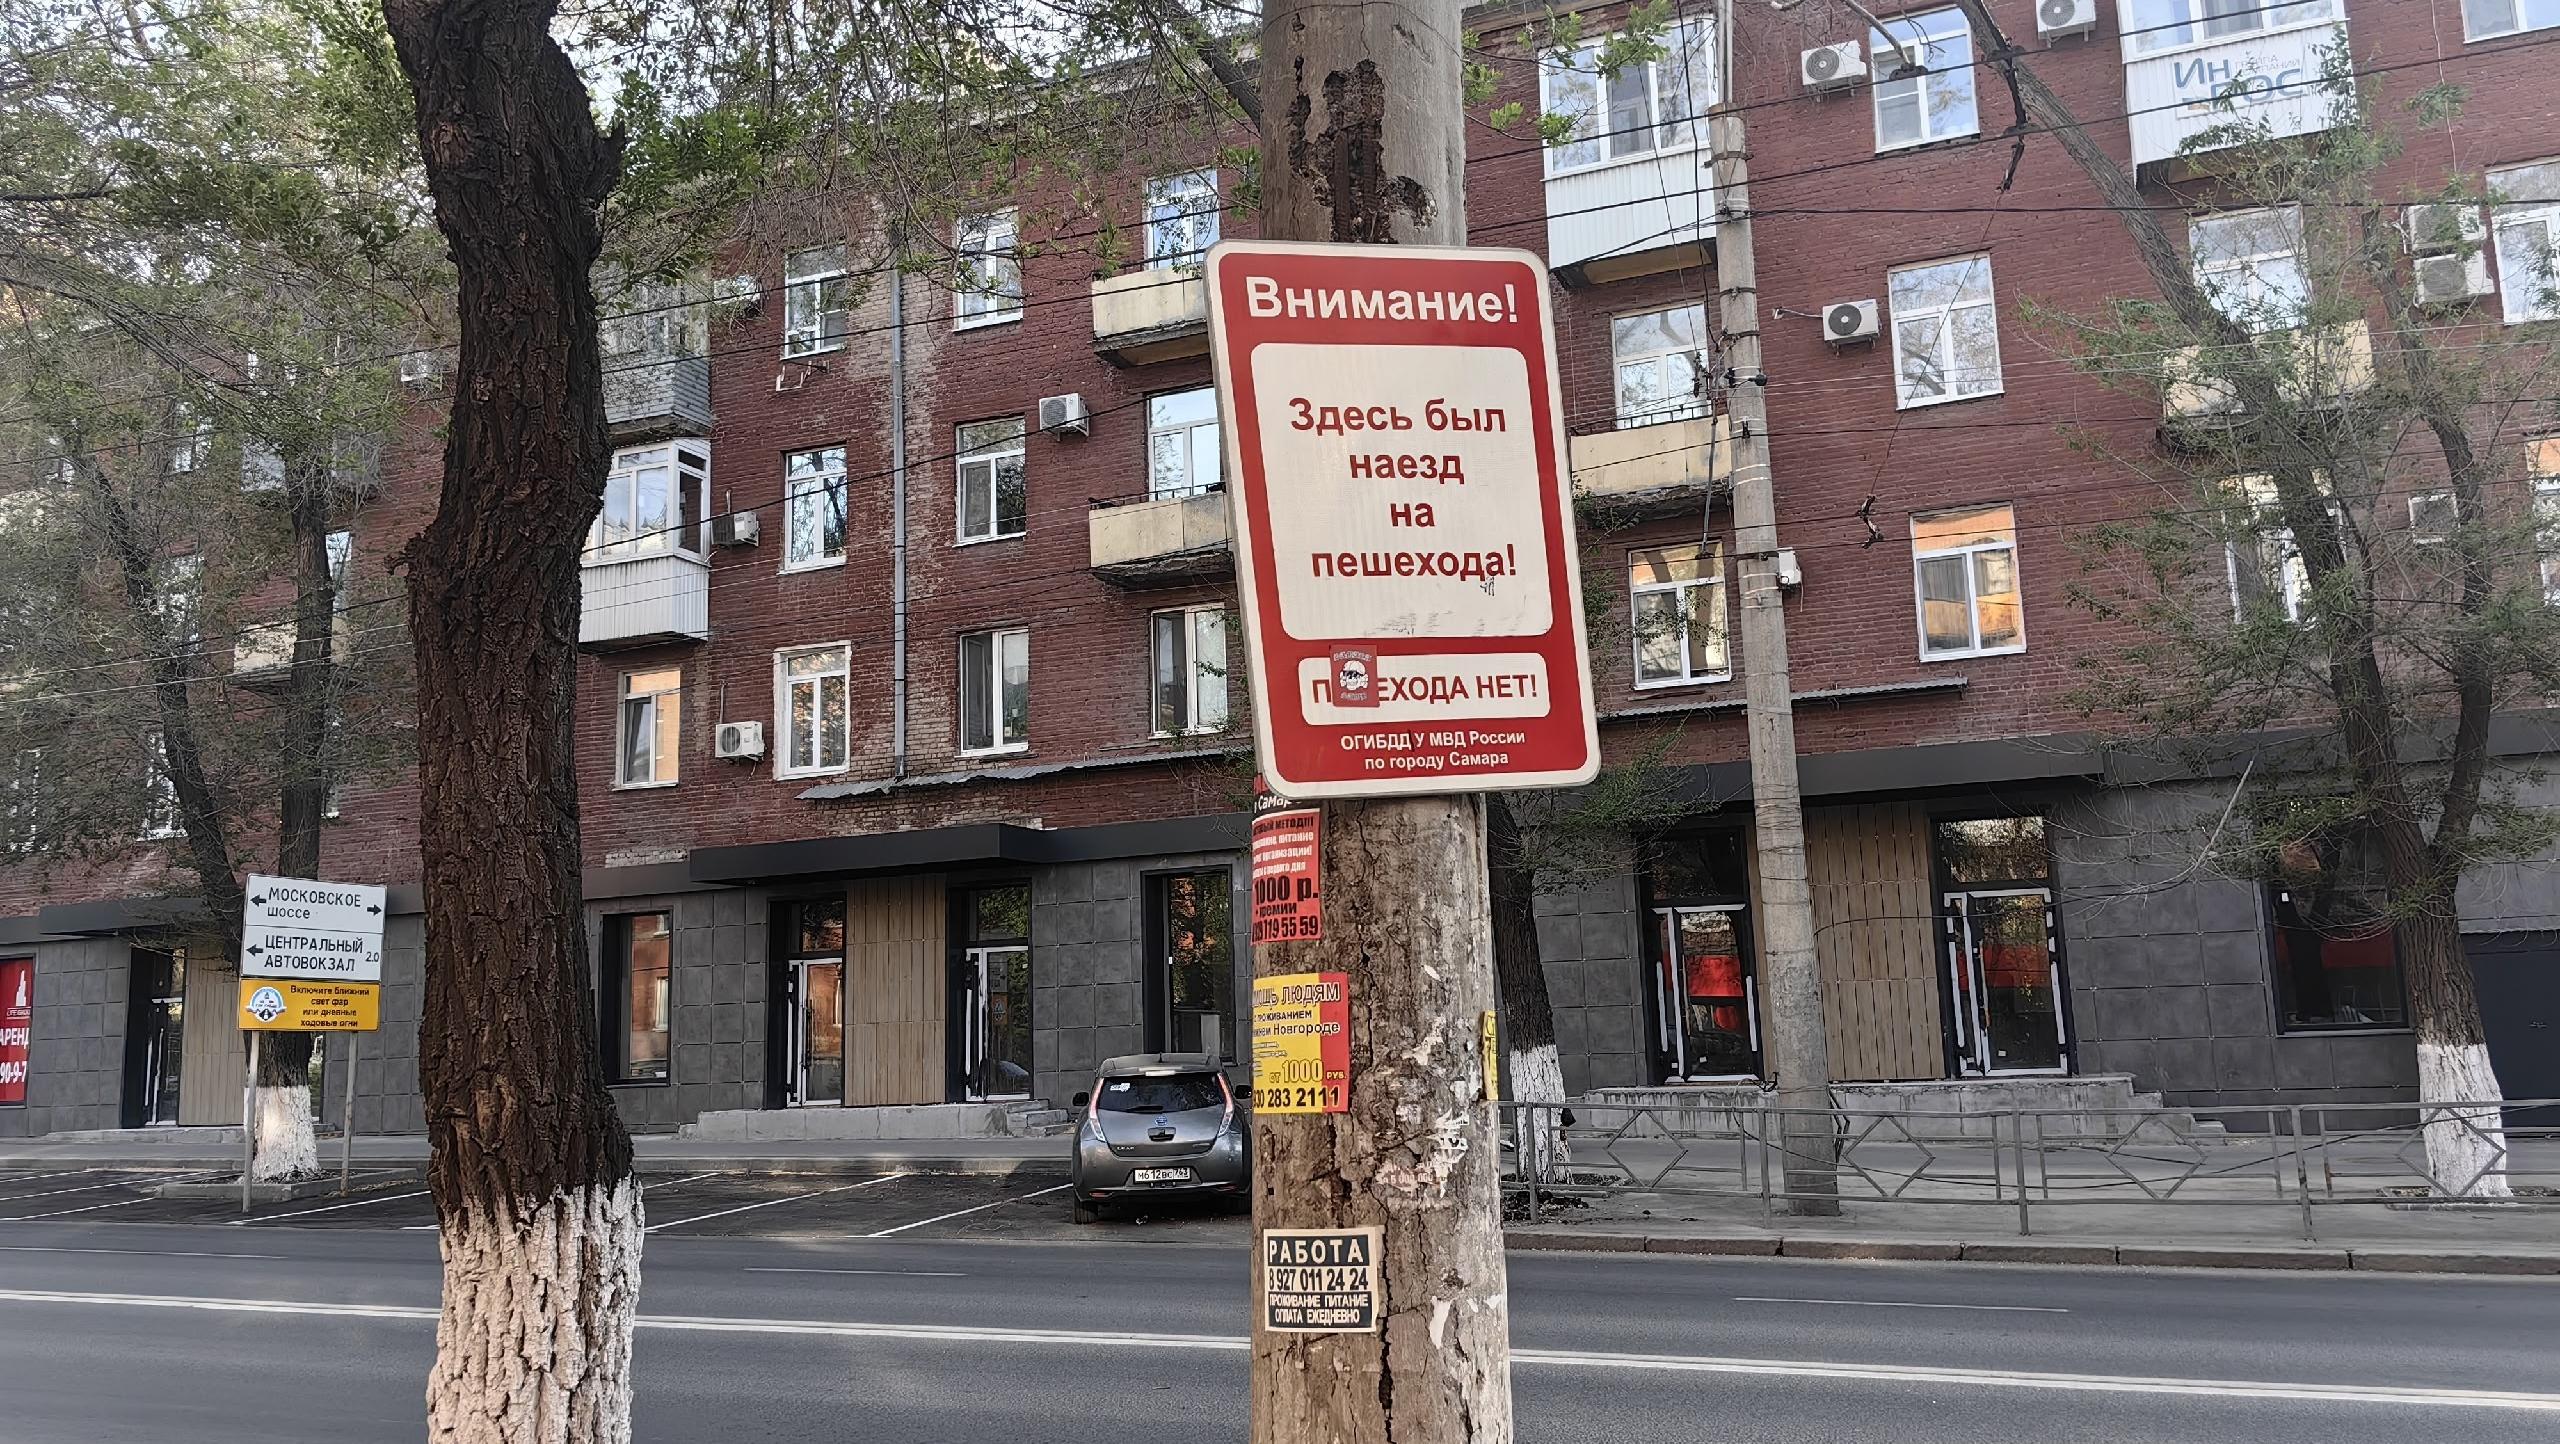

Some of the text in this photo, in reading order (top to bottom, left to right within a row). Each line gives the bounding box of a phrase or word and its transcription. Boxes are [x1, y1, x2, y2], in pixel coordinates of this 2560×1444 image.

[1246, 276, 1518, 323] Внимание!
[1288, 397, 1506, 437] Здесь был
[1349, 453, 1465, 485] наезд
[1390, 502, 1435, 527] на
[1311, 543, 1516, 582] пешехода!
[1312, 673, 1538, 704] ПЕХОДА НЕТ!
[1340, 729, 1526, 751] ОГИБДД У МВД России
[1364, 750, 1509, 773] по городу Самара
[268, 886, 361, 908] МОСКОВСКОЕ
[267, 906, 311, 919] шоссе
[1281, 916, 1297, 938] 55
[1299, 915, 1319, 936] 59
[265, 934, 363, 954] ЦЕНТРАЛЬНЫЙ
[264, 954, 356, 972] АВТОВОКЗАЛ
[364, 951, 380, 963] 2.0
[290, 985, 370, 996] Включите ближний
[1281, 981, 1341, 1008] ЛЮДЯМ
[311, 998, 349, 1007] свет фар
[320, 1009, 357, 1017] дневные
[300, 1019, 358, 1028] ходовые огни
[1273, 1022, 1341, 1037] Новгороде
[1282, 1058, 1323, 1083] 1000
[1267, 1086, 1291, 1108] 283
[1296, 1085, 1341, 1108] 2111
[1269, 1238, 1364, 1264] РАБОТА
[1276, 1267, 1296, 1291] 927
[1299, 1267, 1323, 1291] 011
[1326, 1267, 1346, 1291] 24
[1349, 1267, 1369, 1291] 24
[1269, 1293, 1369, 1308] ПРОЖИВАНИЕ ПИТАНИЕ
[1275, 1308, 1360, 1326] ОПЛАТА ЕЖЕДНЕВНО
